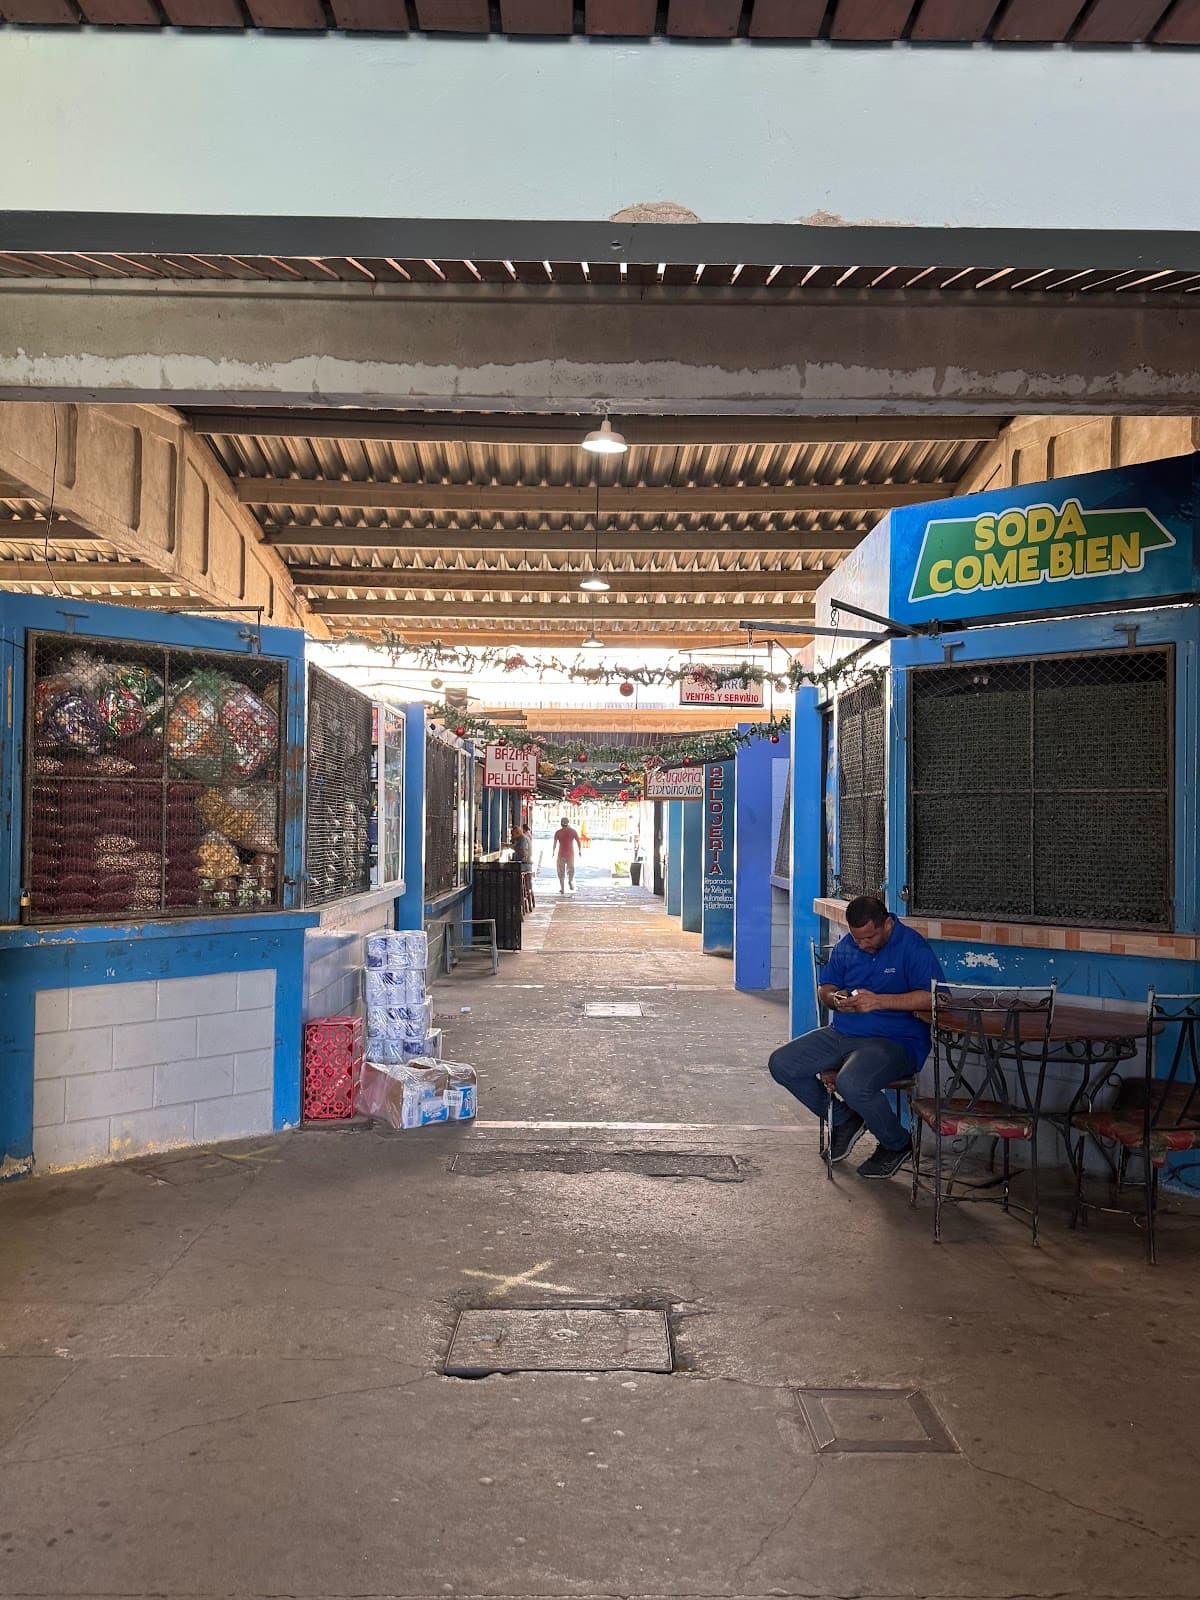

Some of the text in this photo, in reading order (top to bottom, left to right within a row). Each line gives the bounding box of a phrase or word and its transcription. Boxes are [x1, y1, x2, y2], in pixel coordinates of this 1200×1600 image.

[975, 502, 1087, 551] SODA
[929, 532, 1140, 592] COME BIEN
[685, 692, 715, 701] VENTAS
[717, 693, 723, 702] Y
[488, 773, 534, 786] PELUCHE
[505, 762, 518, 771] EL
[709, 766, 724, 875] RELOJERIA
